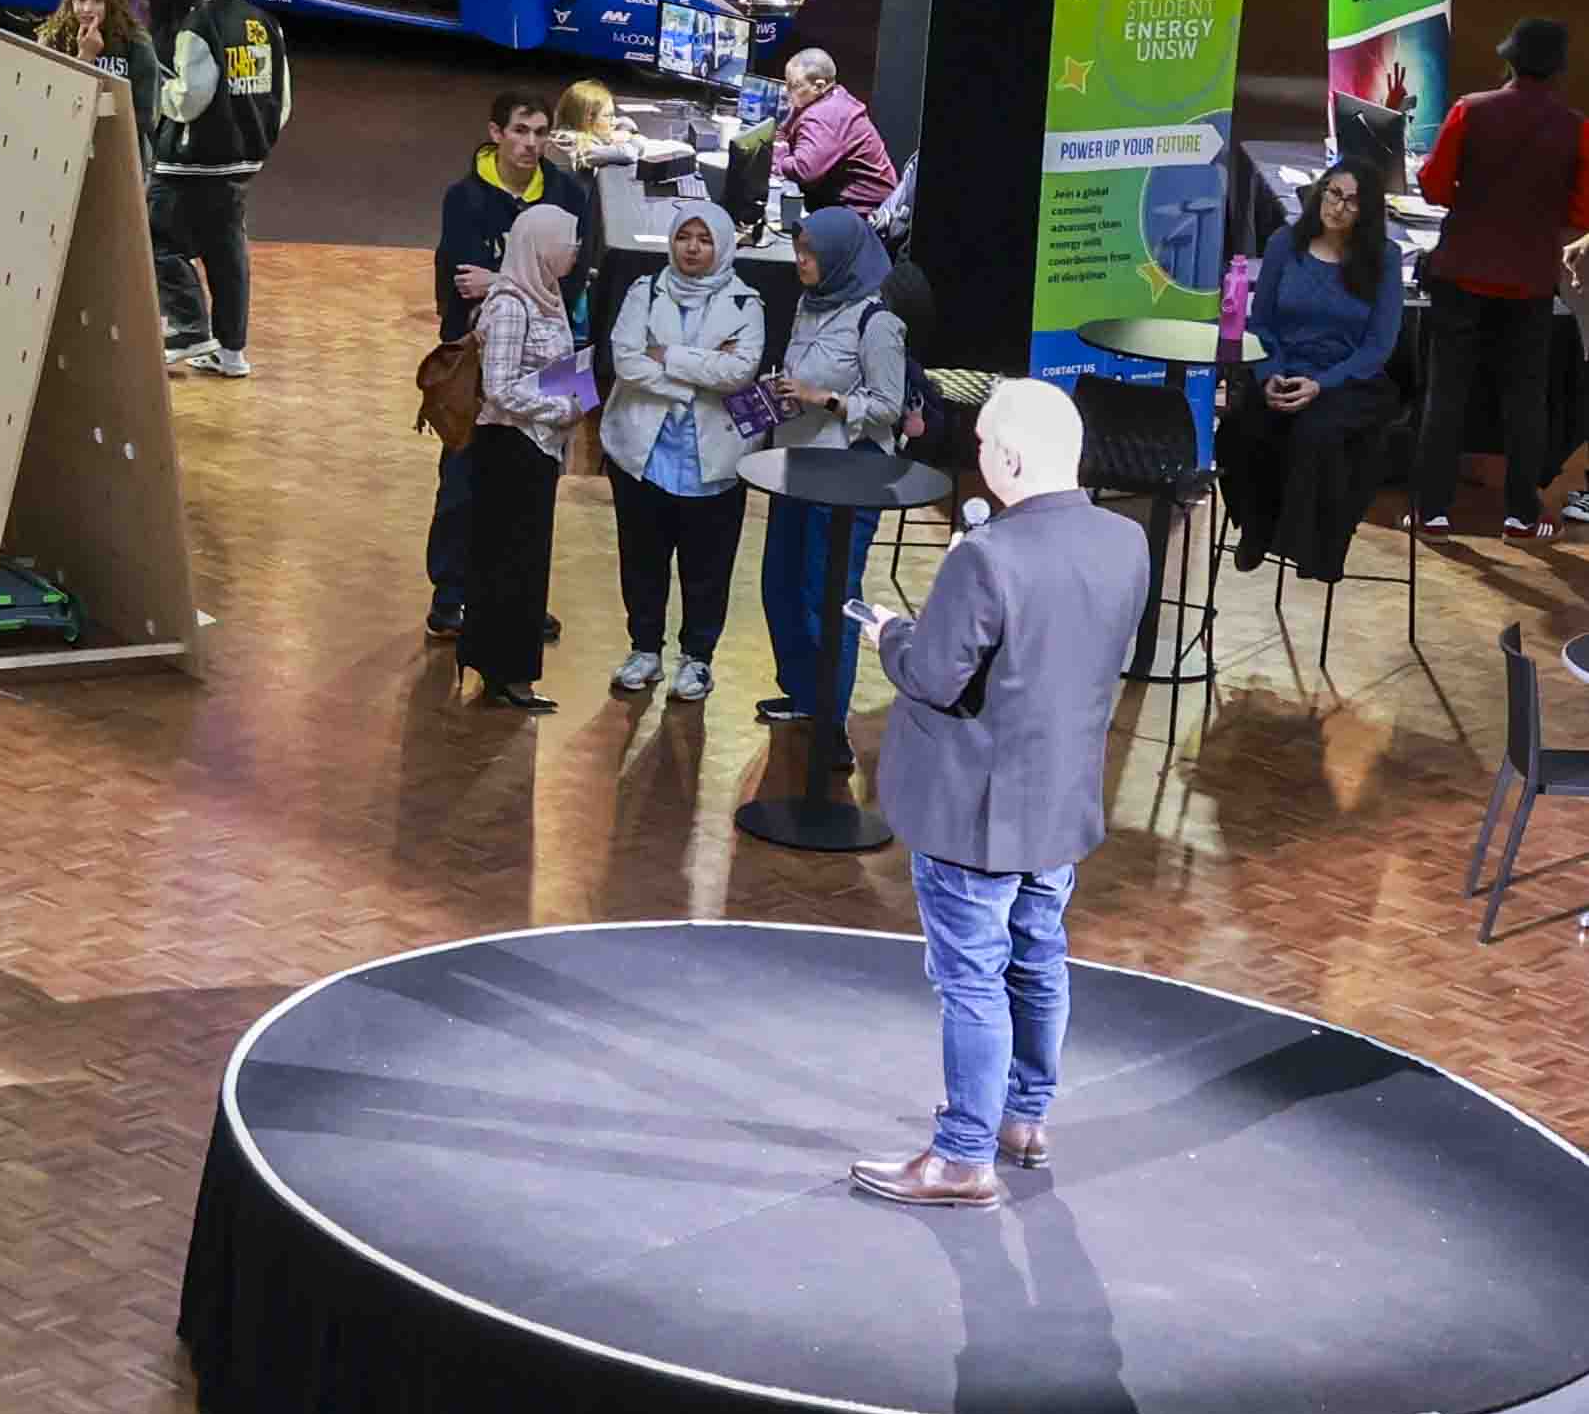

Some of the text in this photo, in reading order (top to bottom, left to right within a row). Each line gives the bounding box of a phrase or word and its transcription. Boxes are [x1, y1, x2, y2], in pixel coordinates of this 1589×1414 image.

[1124, 18, 1214, 41] ENERGY
[1136, 39, 1198, 62] UNSW
[1061, 133, 1202, 160] POWER UP YOUR FUTURE
[1042, 363, 1096, 377] CONTACT US
